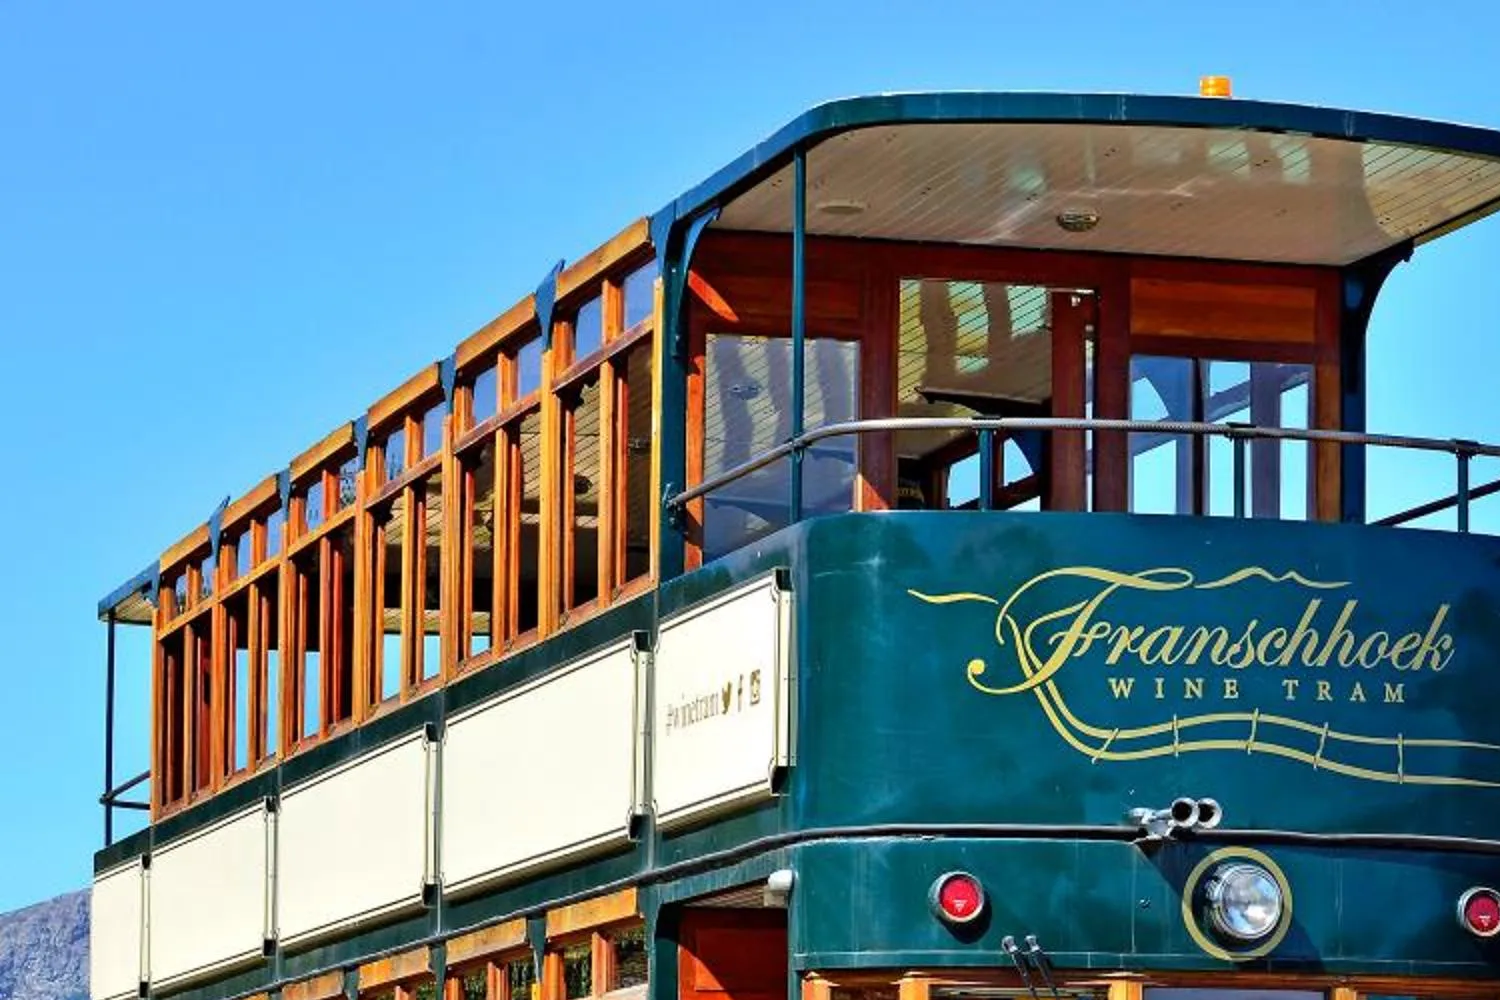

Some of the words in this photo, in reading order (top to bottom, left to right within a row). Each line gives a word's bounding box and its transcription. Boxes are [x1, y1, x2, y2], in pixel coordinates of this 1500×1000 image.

[967, 566, 1454, 693] Franschhoek
[1109, 677, 1239, 700] WINE
[1283, 679, 1406, 704] TRAM
